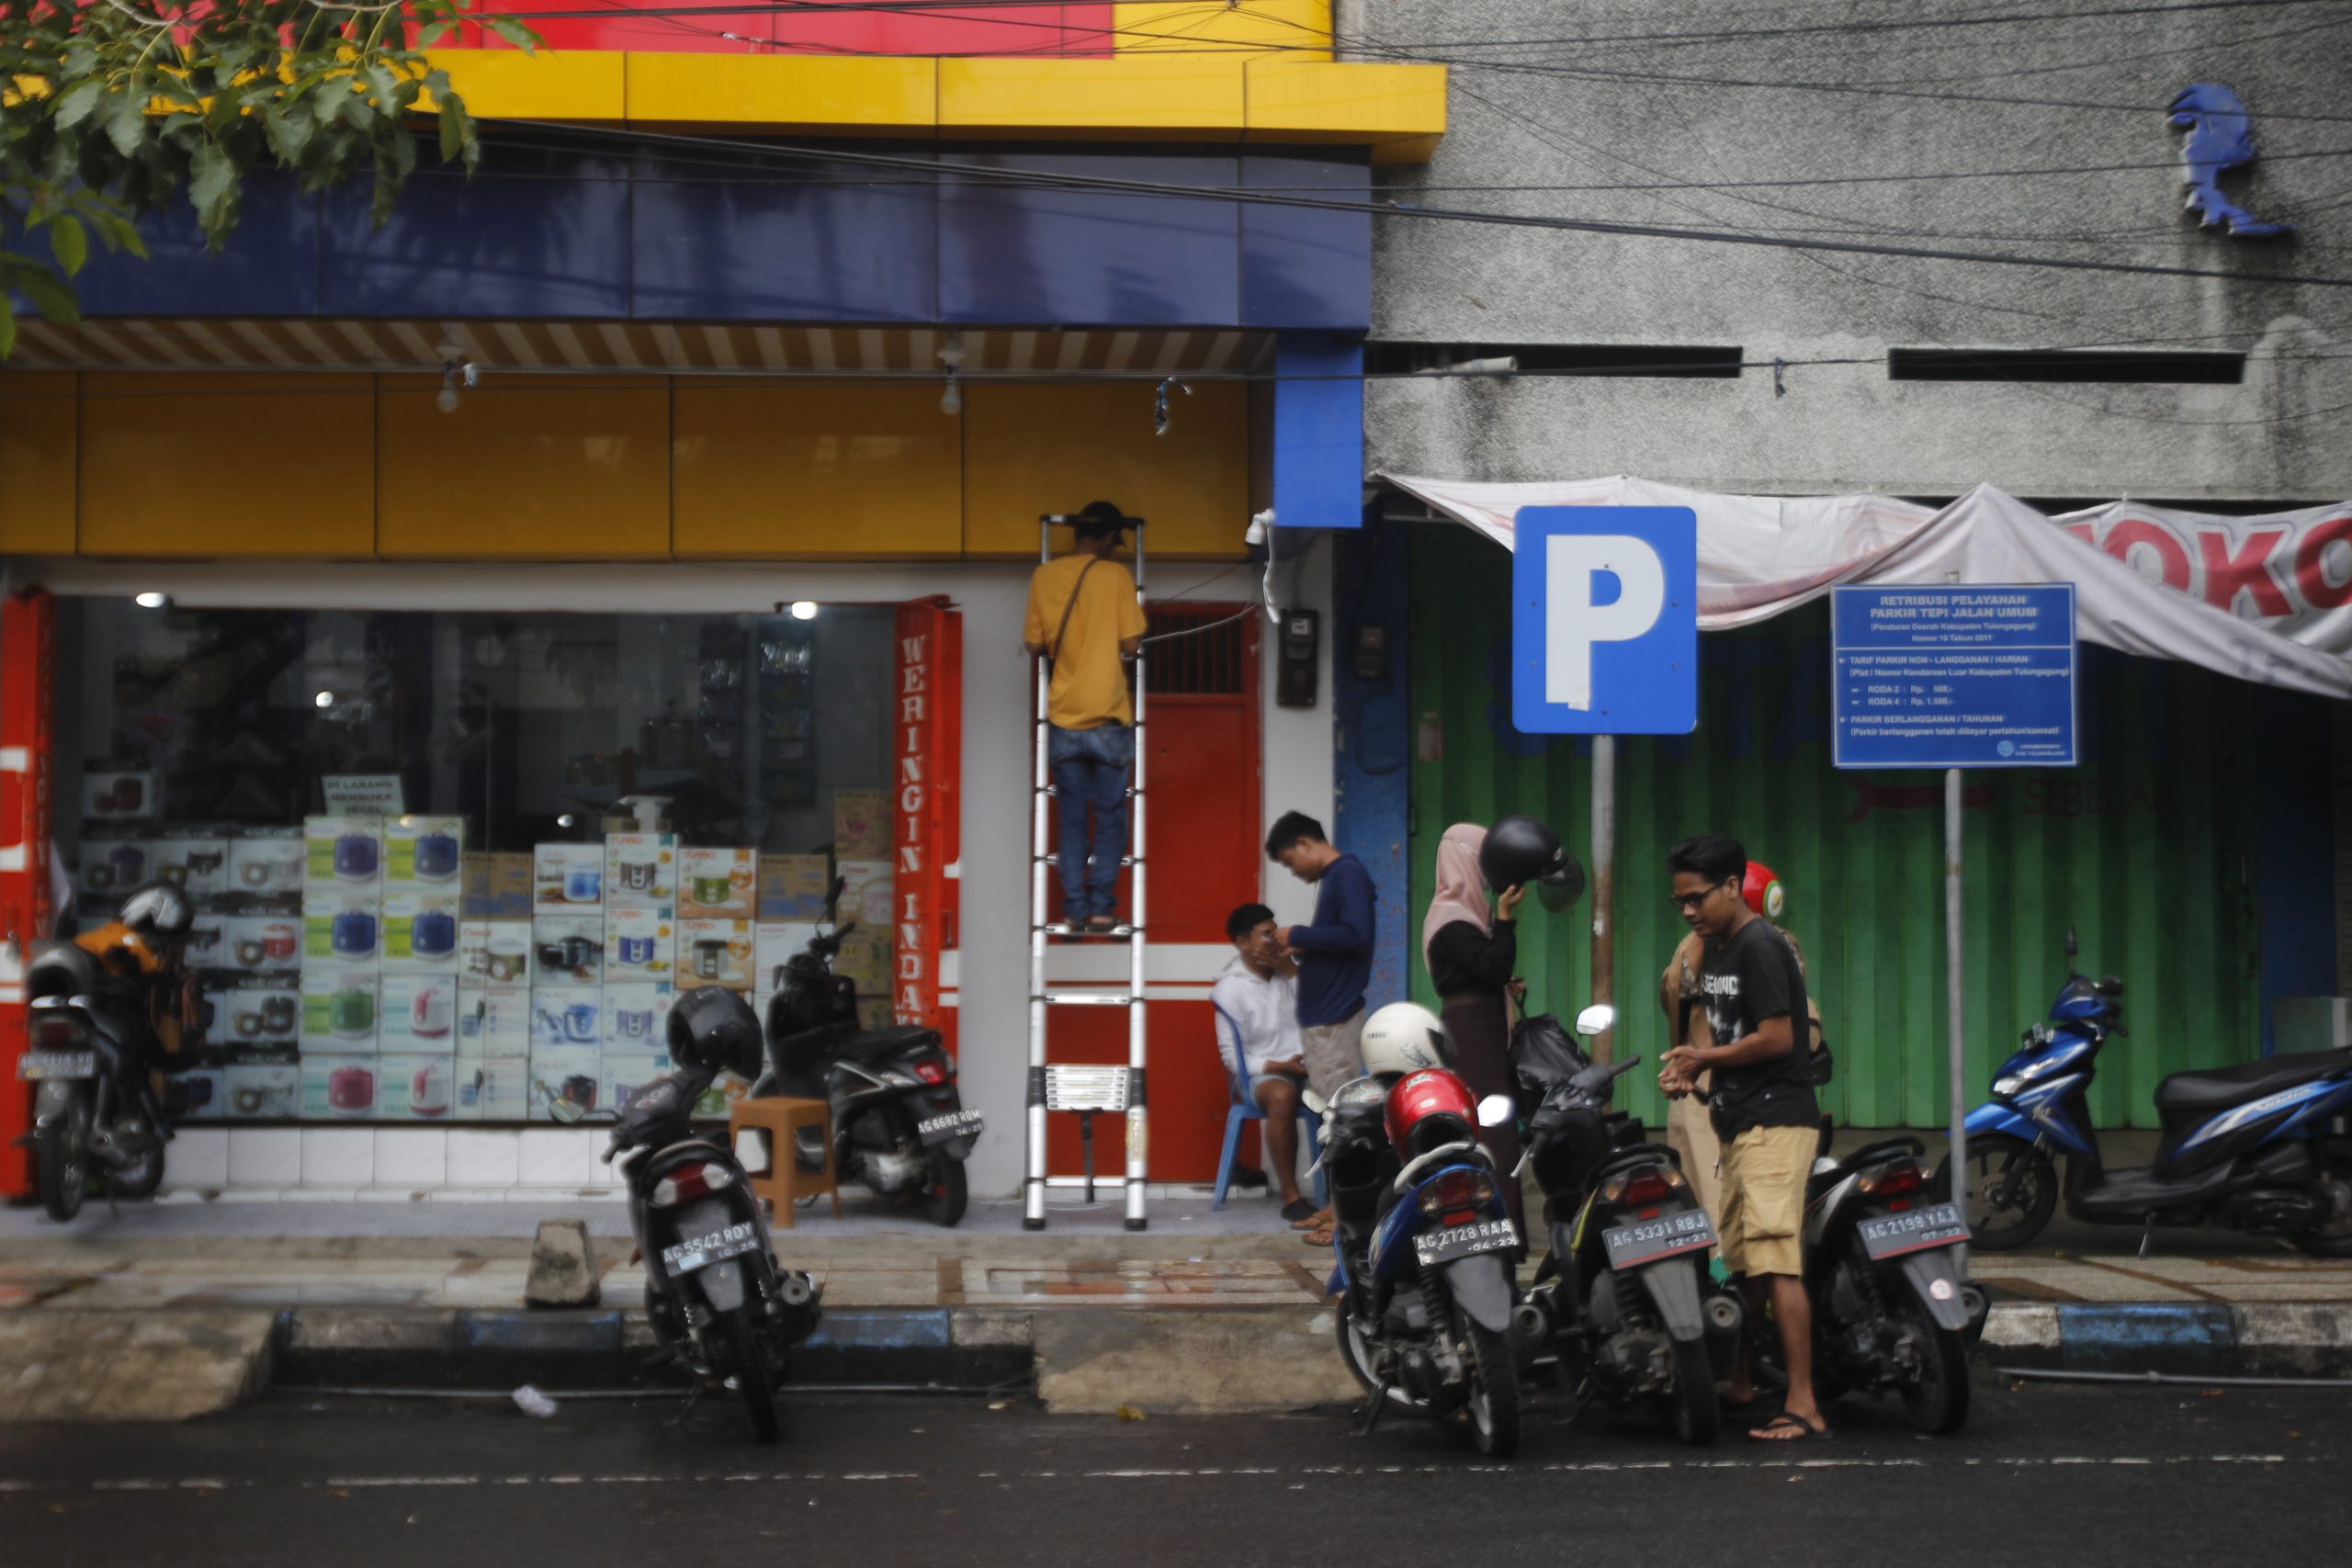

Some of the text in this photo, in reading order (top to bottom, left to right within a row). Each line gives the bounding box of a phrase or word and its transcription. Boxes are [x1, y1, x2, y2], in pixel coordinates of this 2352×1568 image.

[2067, 517, 2352, 617] OKO
[1880, 595, 2027, 605] RETRIBUSI PELAYANAN
[1871, 607, 2037, 618] PARKIR TEPI JALAN UMUM
[1545, 535, 1664, 711] P
[1940, 622, 1982, 632] Kabupaten
[1911, 634, 1938, 642] Nomor
[1849, 656, 1874, 665] TARIF
[1875, 656, 1908, 664] PARKIR
[1909, 656, 1928, 664] NON
[1934, 655, 1989, 664] LANGGANAN
[1995, 655, 2029, 663] HARIAN
[1904, 668, 1947, 676] Kendaraan
[1949, 668, 1966, 676] Luar
[1968, 667, 2012, 677] Kabupaten
[1868, 685, 1893, 694] RODA
[1868, 697, 1893, 705] RODA
[1850, 716, 1882, 724] PARKIR
[1962, 715, 2003, 723] TAHUNAN
[1879, 728, 1934, 738] berlangganan
[1957, 727, 1987, 737] dibayar
[899, 637, 926, 874] WERINGIN
[919, 1121, 932, 1134] AG
[1613, 1230, 1633, 1247] AG
[1634, 1219, 1672, 1242] 5331
[1867, 1223, 1888, 1240] AG
[1417, 1235, 1436, 1250] AG
[1438, 1226, 1477, 1246] 2728
[663, 1245, 682, 1263] AG
